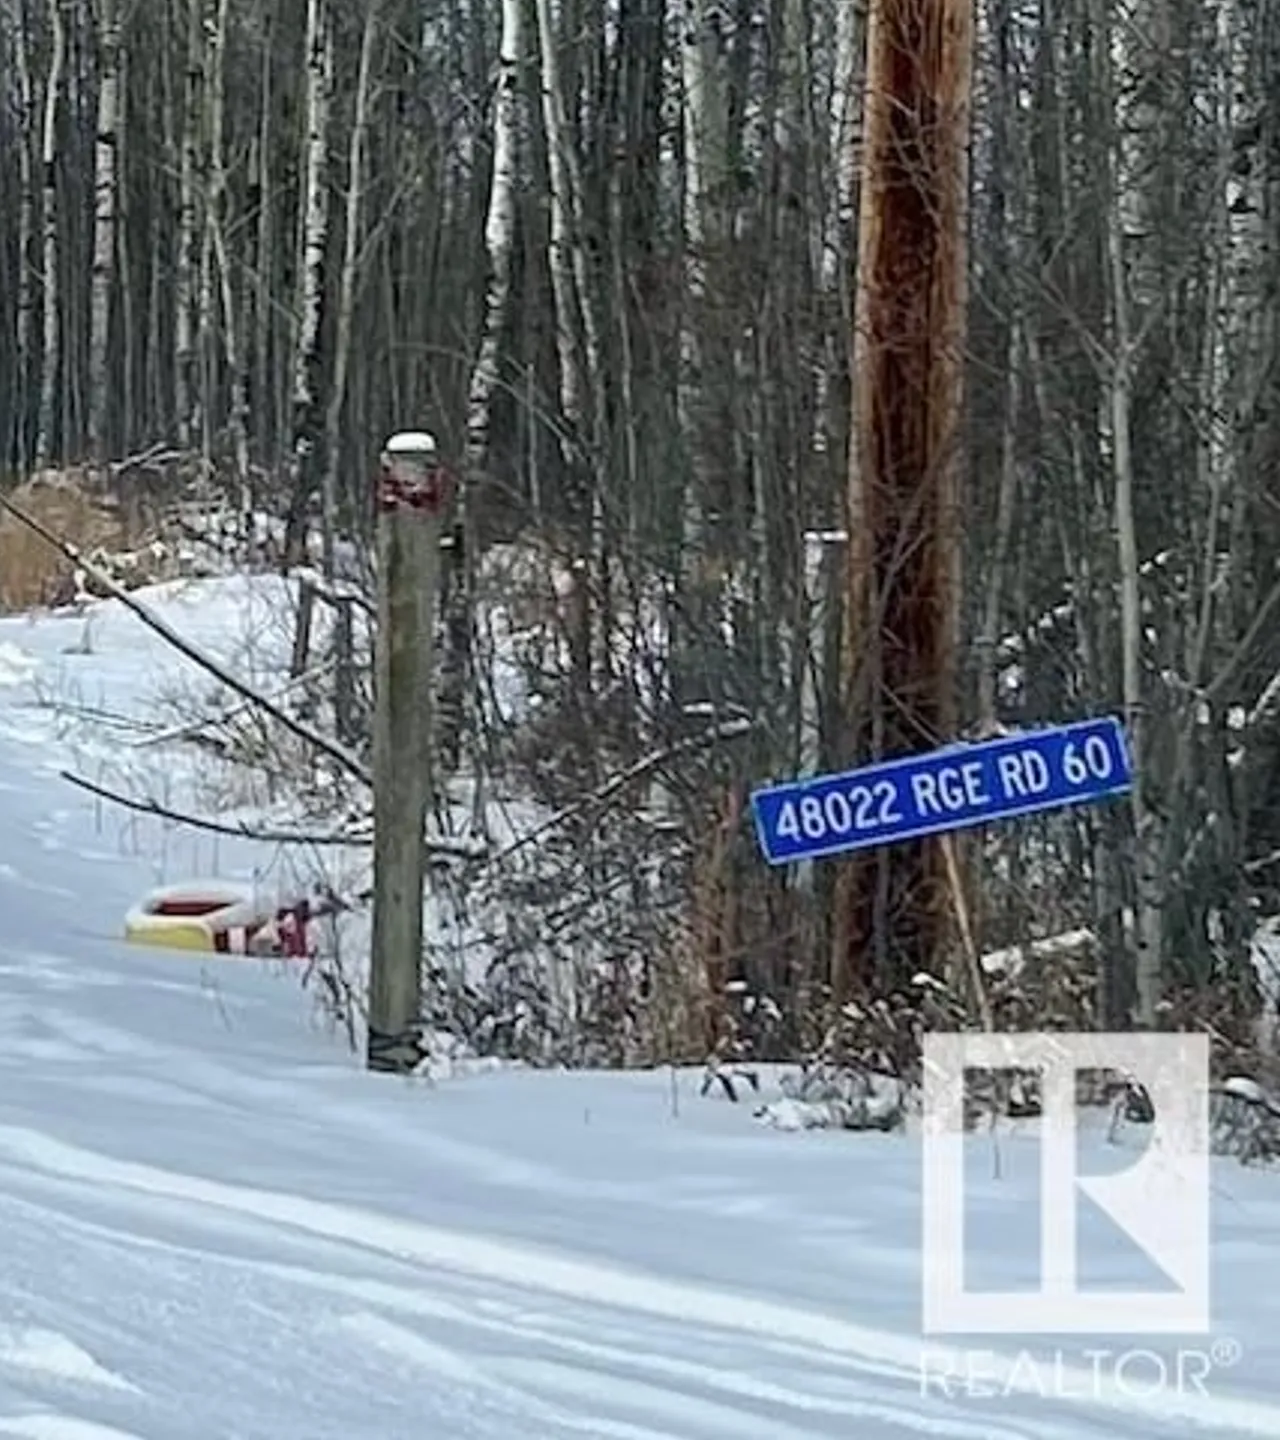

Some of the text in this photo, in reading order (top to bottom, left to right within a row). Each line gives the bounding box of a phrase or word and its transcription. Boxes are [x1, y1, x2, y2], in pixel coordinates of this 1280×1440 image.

[776, 735, 1112, 843] 48022 RGE RD 60
